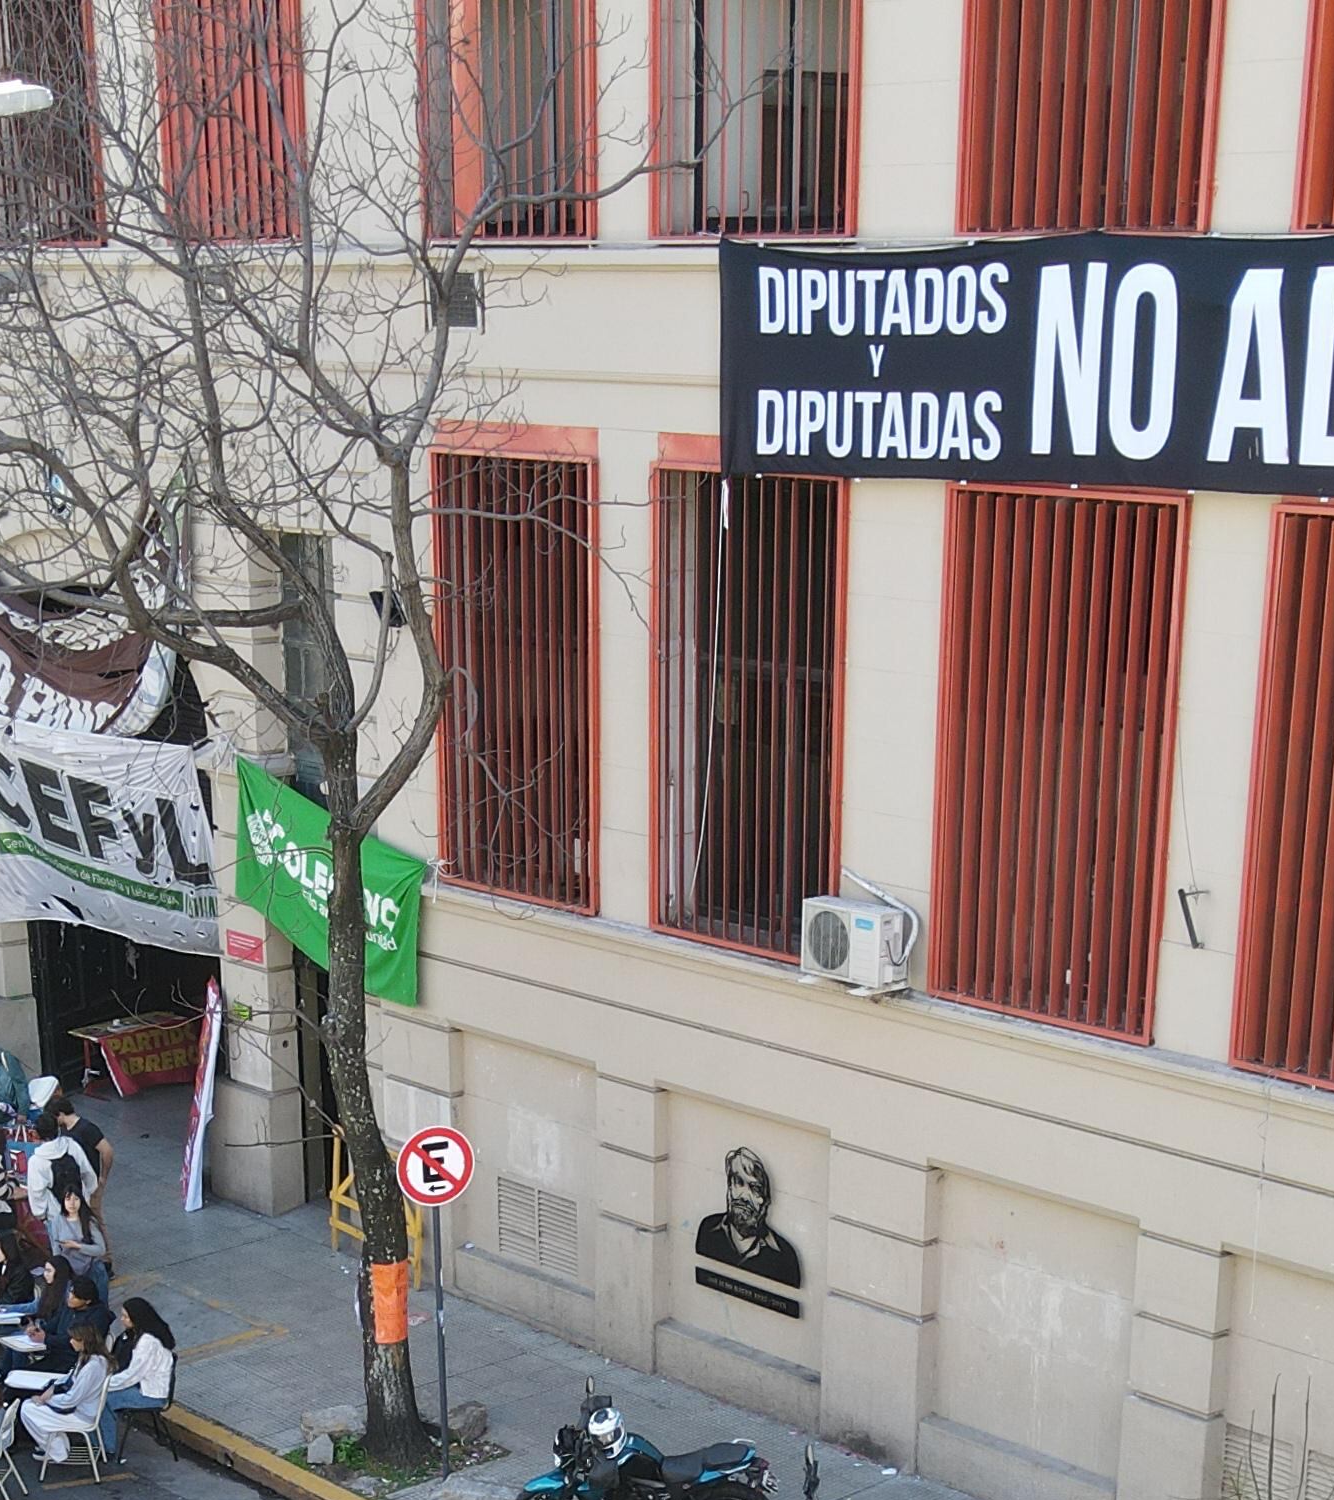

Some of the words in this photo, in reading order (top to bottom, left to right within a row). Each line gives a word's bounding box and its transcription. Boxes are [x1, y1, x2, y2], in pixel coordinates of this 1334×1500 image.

[758, 262, 1009, 336] DIPUTADOS
[869, 344, 884, 379] Y
[1030, 260, 1179, 460] NO
[756, 389, 1003, 461] DIPUTADAS
[421, 1140, 449, 1184] E
